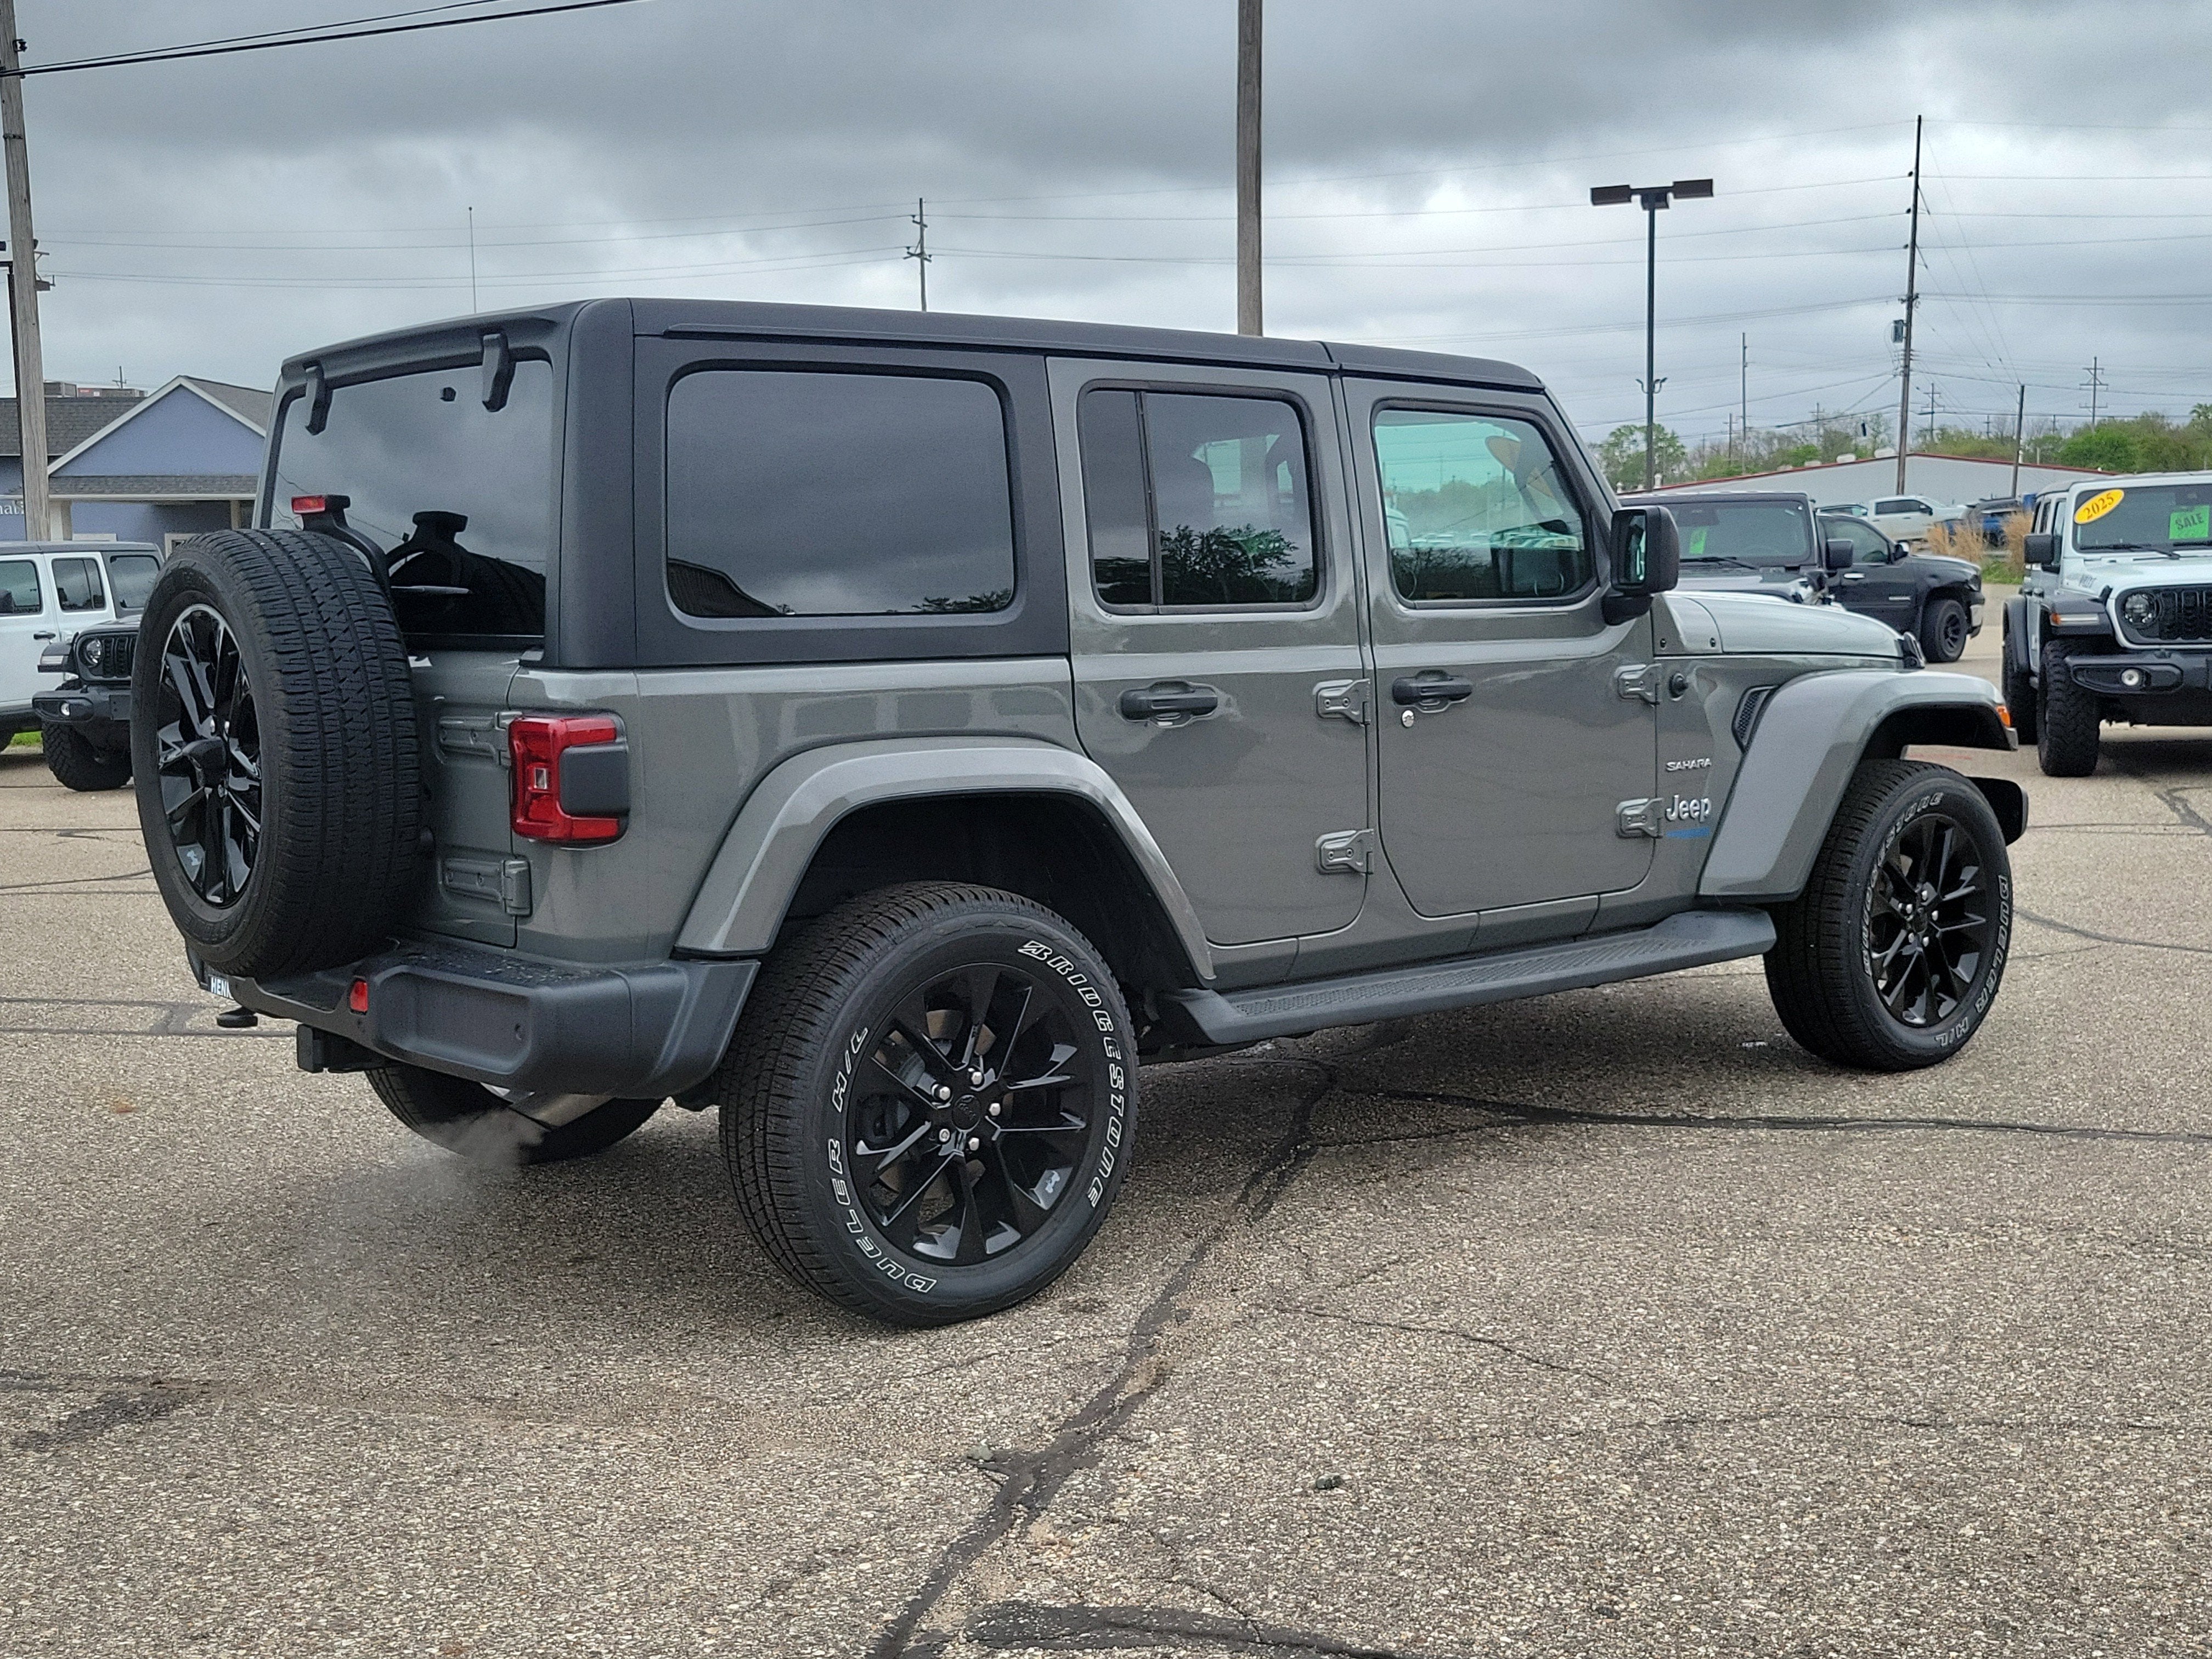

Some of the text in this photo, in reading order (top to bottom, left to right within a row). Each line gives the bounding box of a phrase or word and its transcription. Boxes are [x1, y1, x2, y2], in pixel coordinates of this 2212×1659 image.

[2084, 493, 2114, 519] 2025
[2175, 513, 2204, 529] SALE
[1666, 758, 1712, 771] SAHARA
[1666, 794, 1711, 823] Jeep
[1018, 940, 1125, 1208] BRIDGESTONE
[827, 1138, 937, 1293] DUELER
